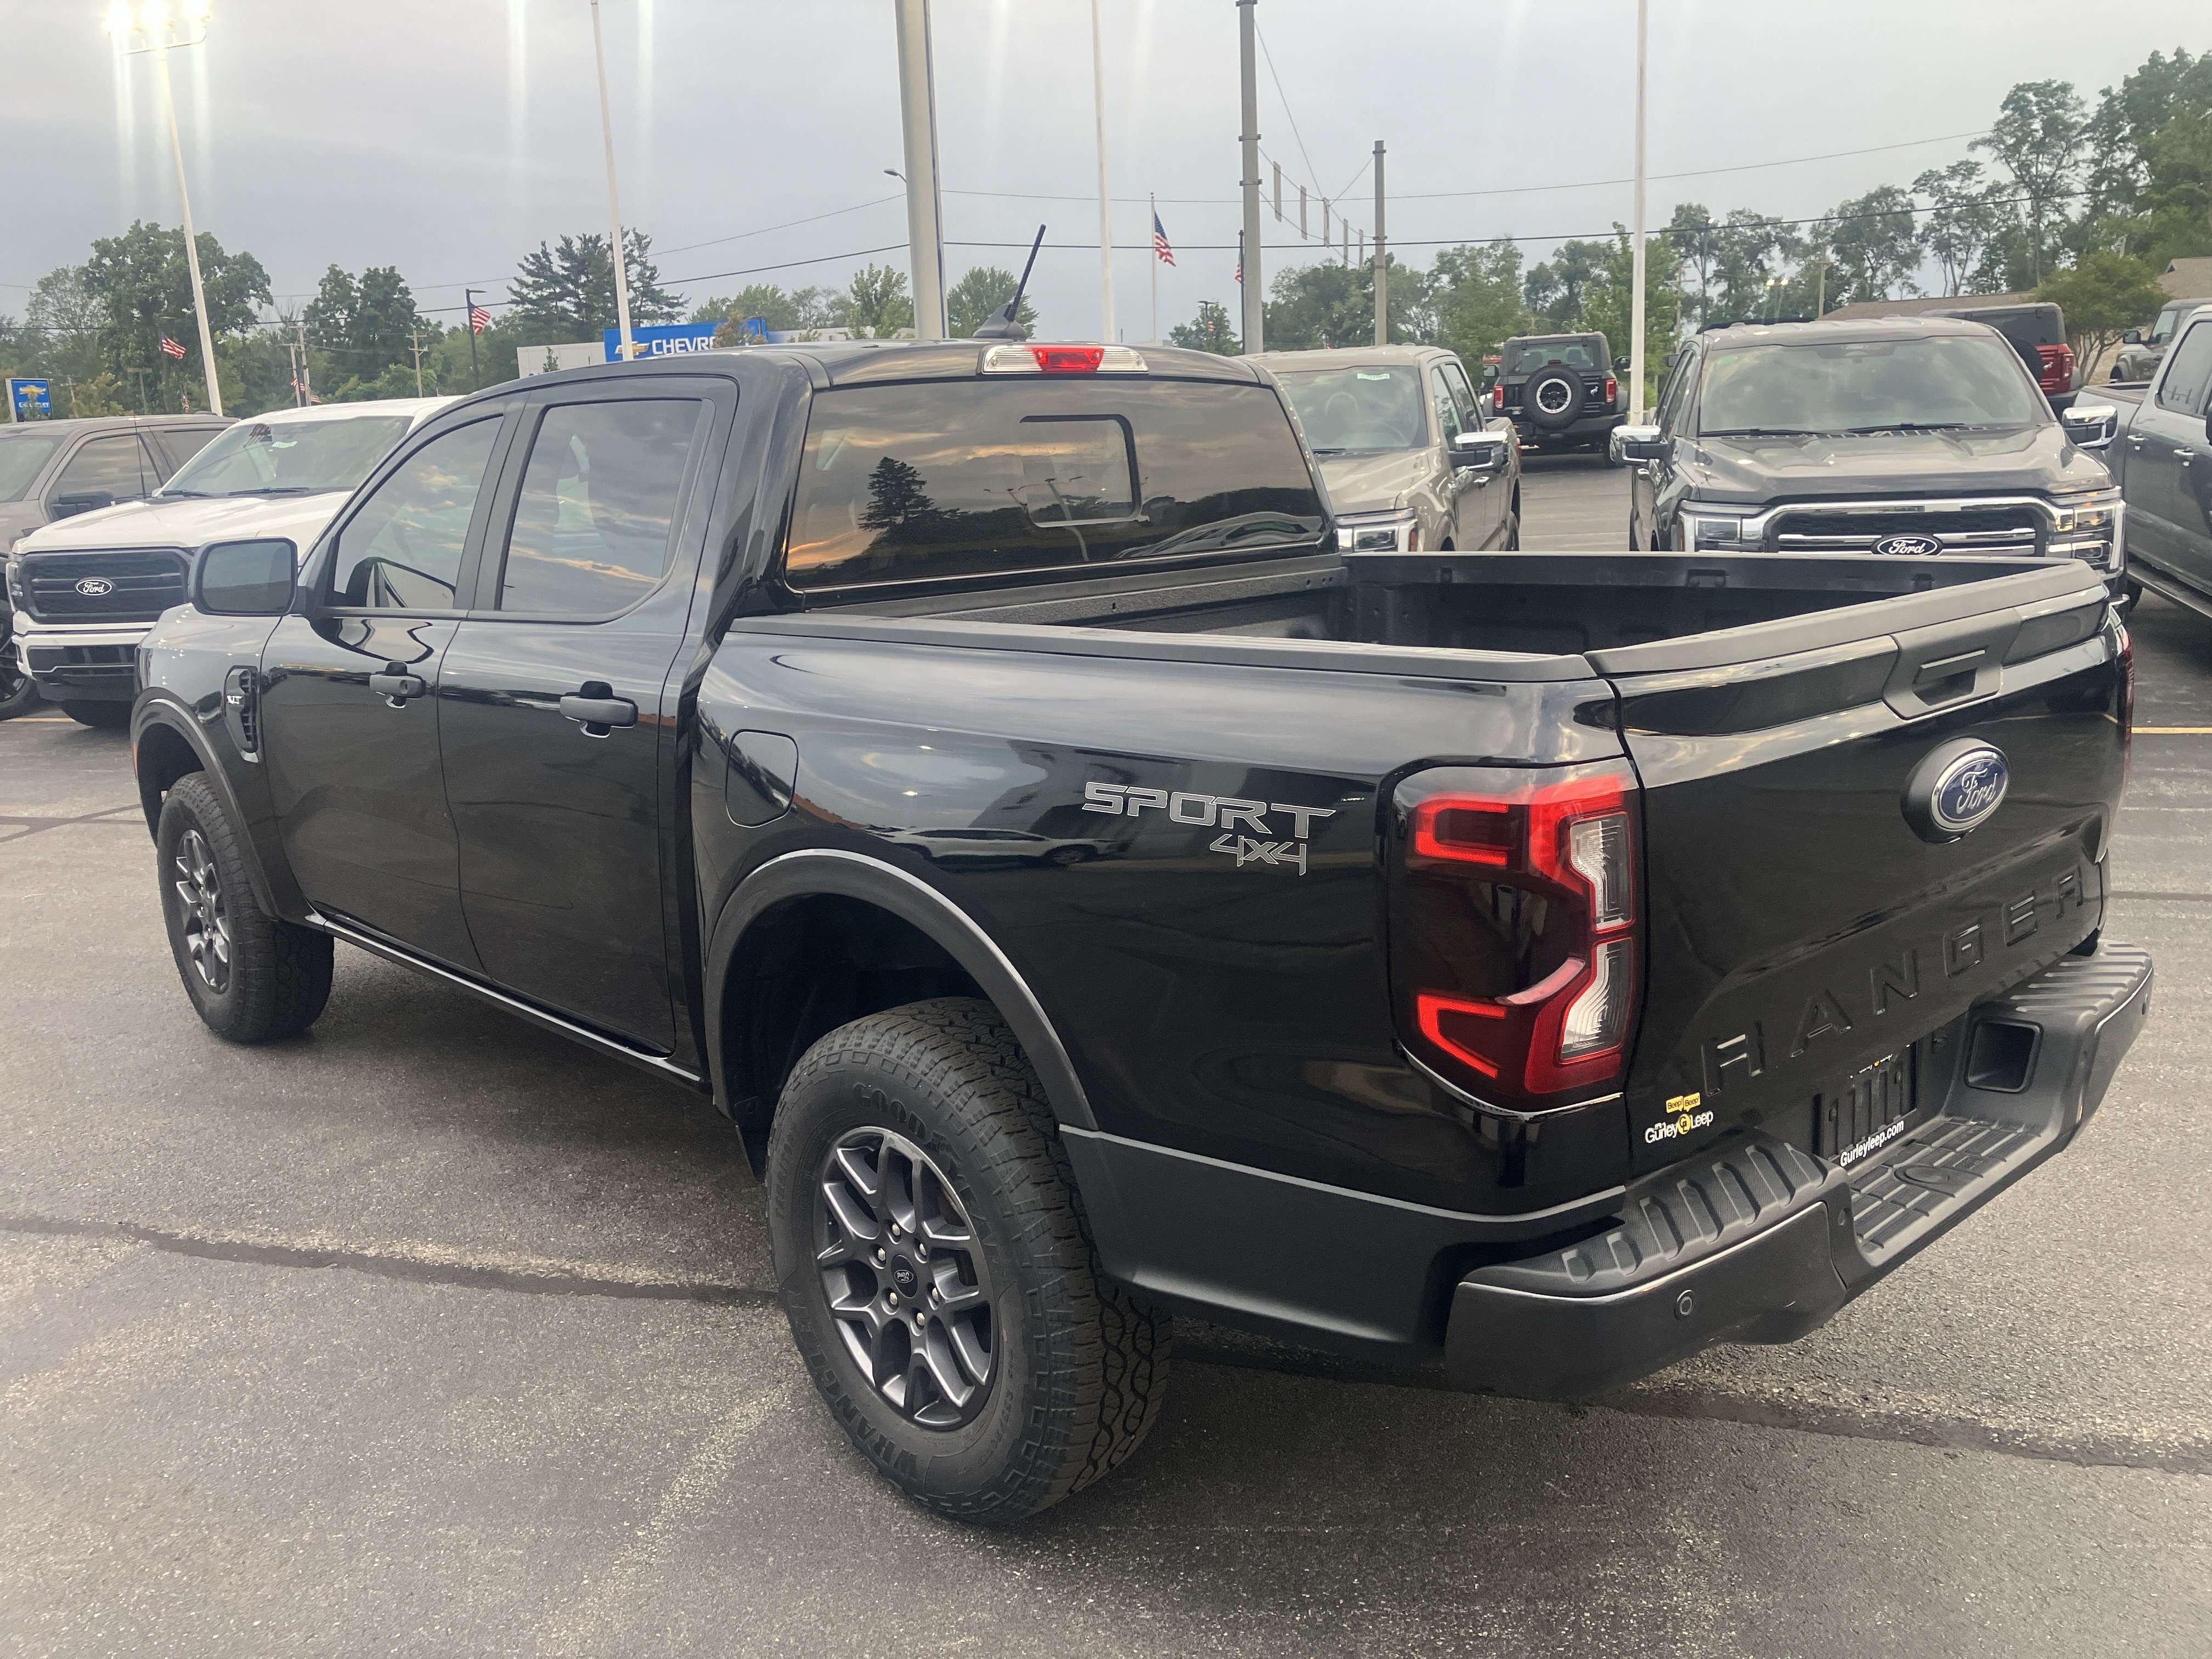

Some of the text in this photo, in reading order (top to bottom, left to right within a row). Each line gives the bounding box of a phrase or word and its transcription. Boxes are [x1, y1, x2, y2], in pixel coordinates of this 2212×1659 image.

[652, 336, 716, 355] CHEVR
[1888, 539, 1926, 554] Ford
[83, 582, 105, 593] Ford
[1956, 768, 1998, 815] Ford
[1082, 781, 1336, 839] SPORT
[1701, 864, 2084, 1097] RANGER
[1667, 1096, 1700, 1109] Beep! Beep!
[1645, 1122, 1679, 1143] Gurley
[1690, 1111, 1714, 1127] Leep
[1840, 1120, 1904, 1167] Gurleyleep.com
[897, 1272, 910, 1282] Ford
